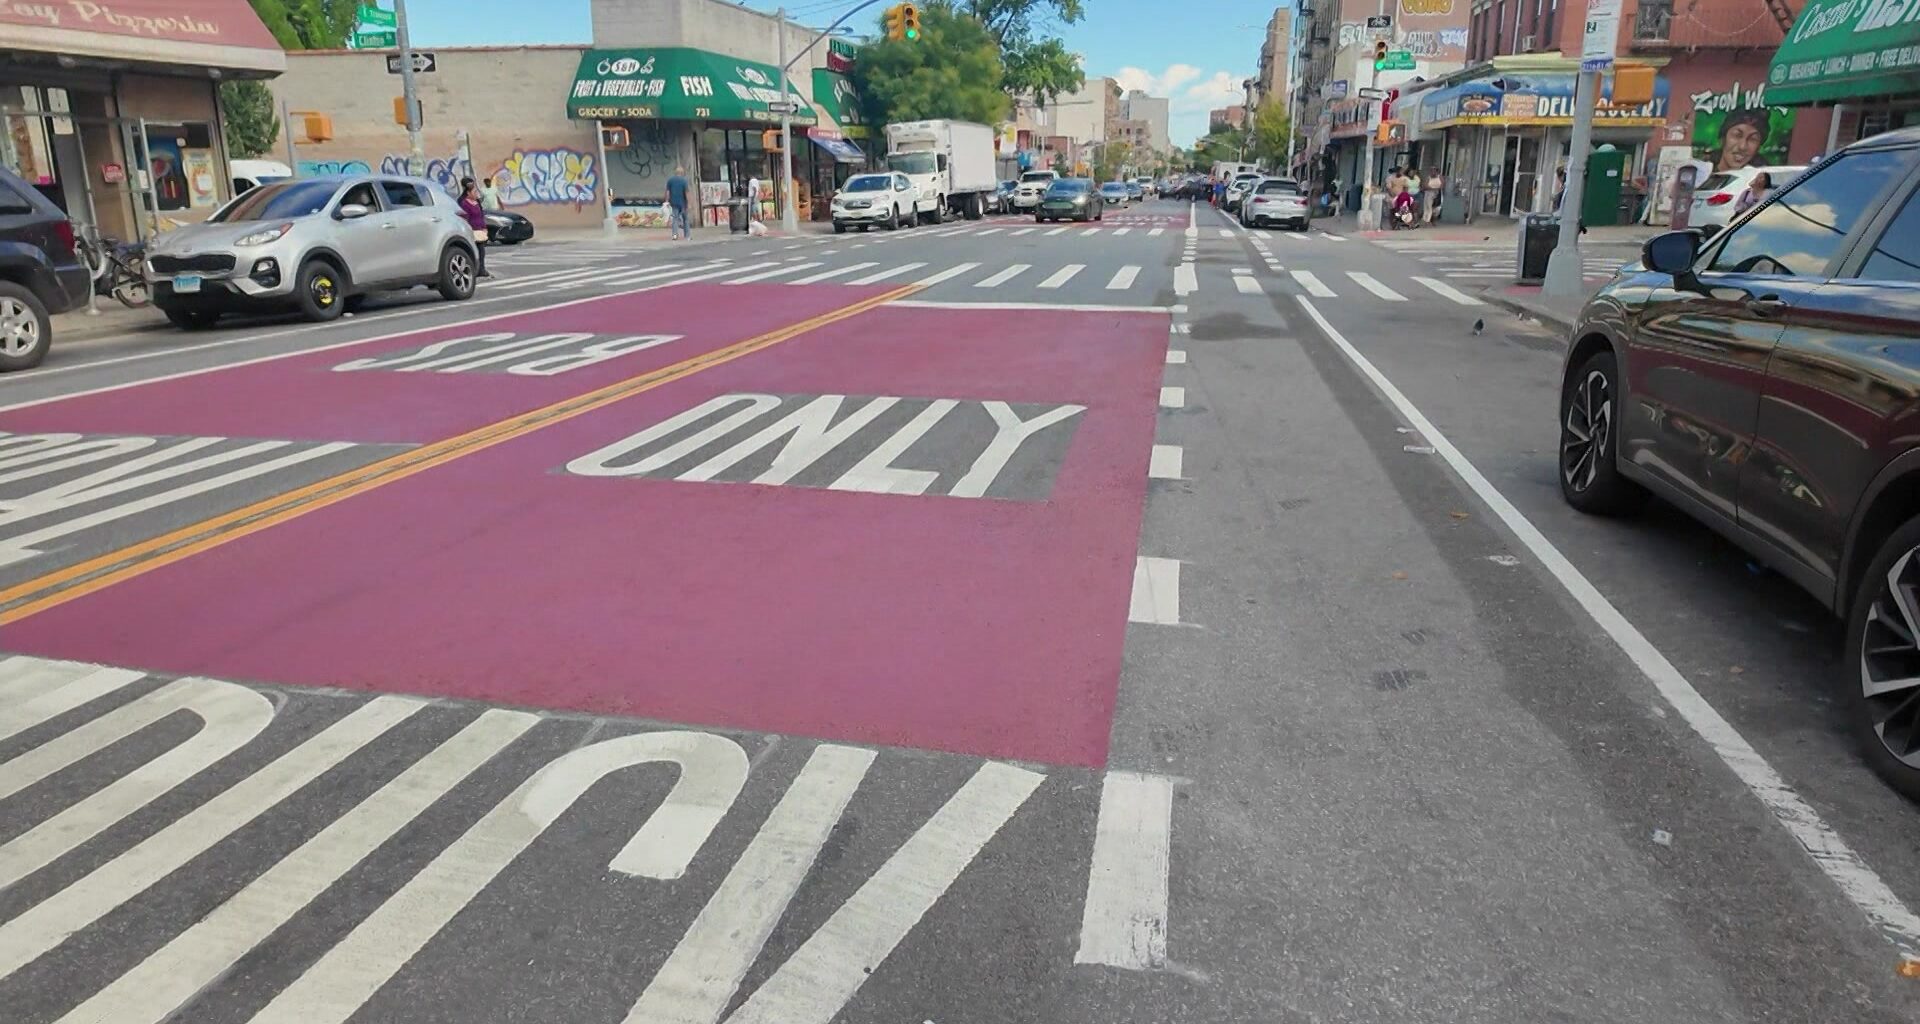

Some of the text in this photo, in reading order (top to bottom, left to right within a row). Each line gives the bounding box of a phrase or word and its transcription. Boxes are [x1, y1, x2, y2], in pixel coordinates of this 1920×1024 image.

[70, 0, 219, 35] Pizzeria
[680, 76, 713, 96] FISH
[578, 107, 652, 117] GROCERY SODA
[567, 393, 1087, 499] ONLY
